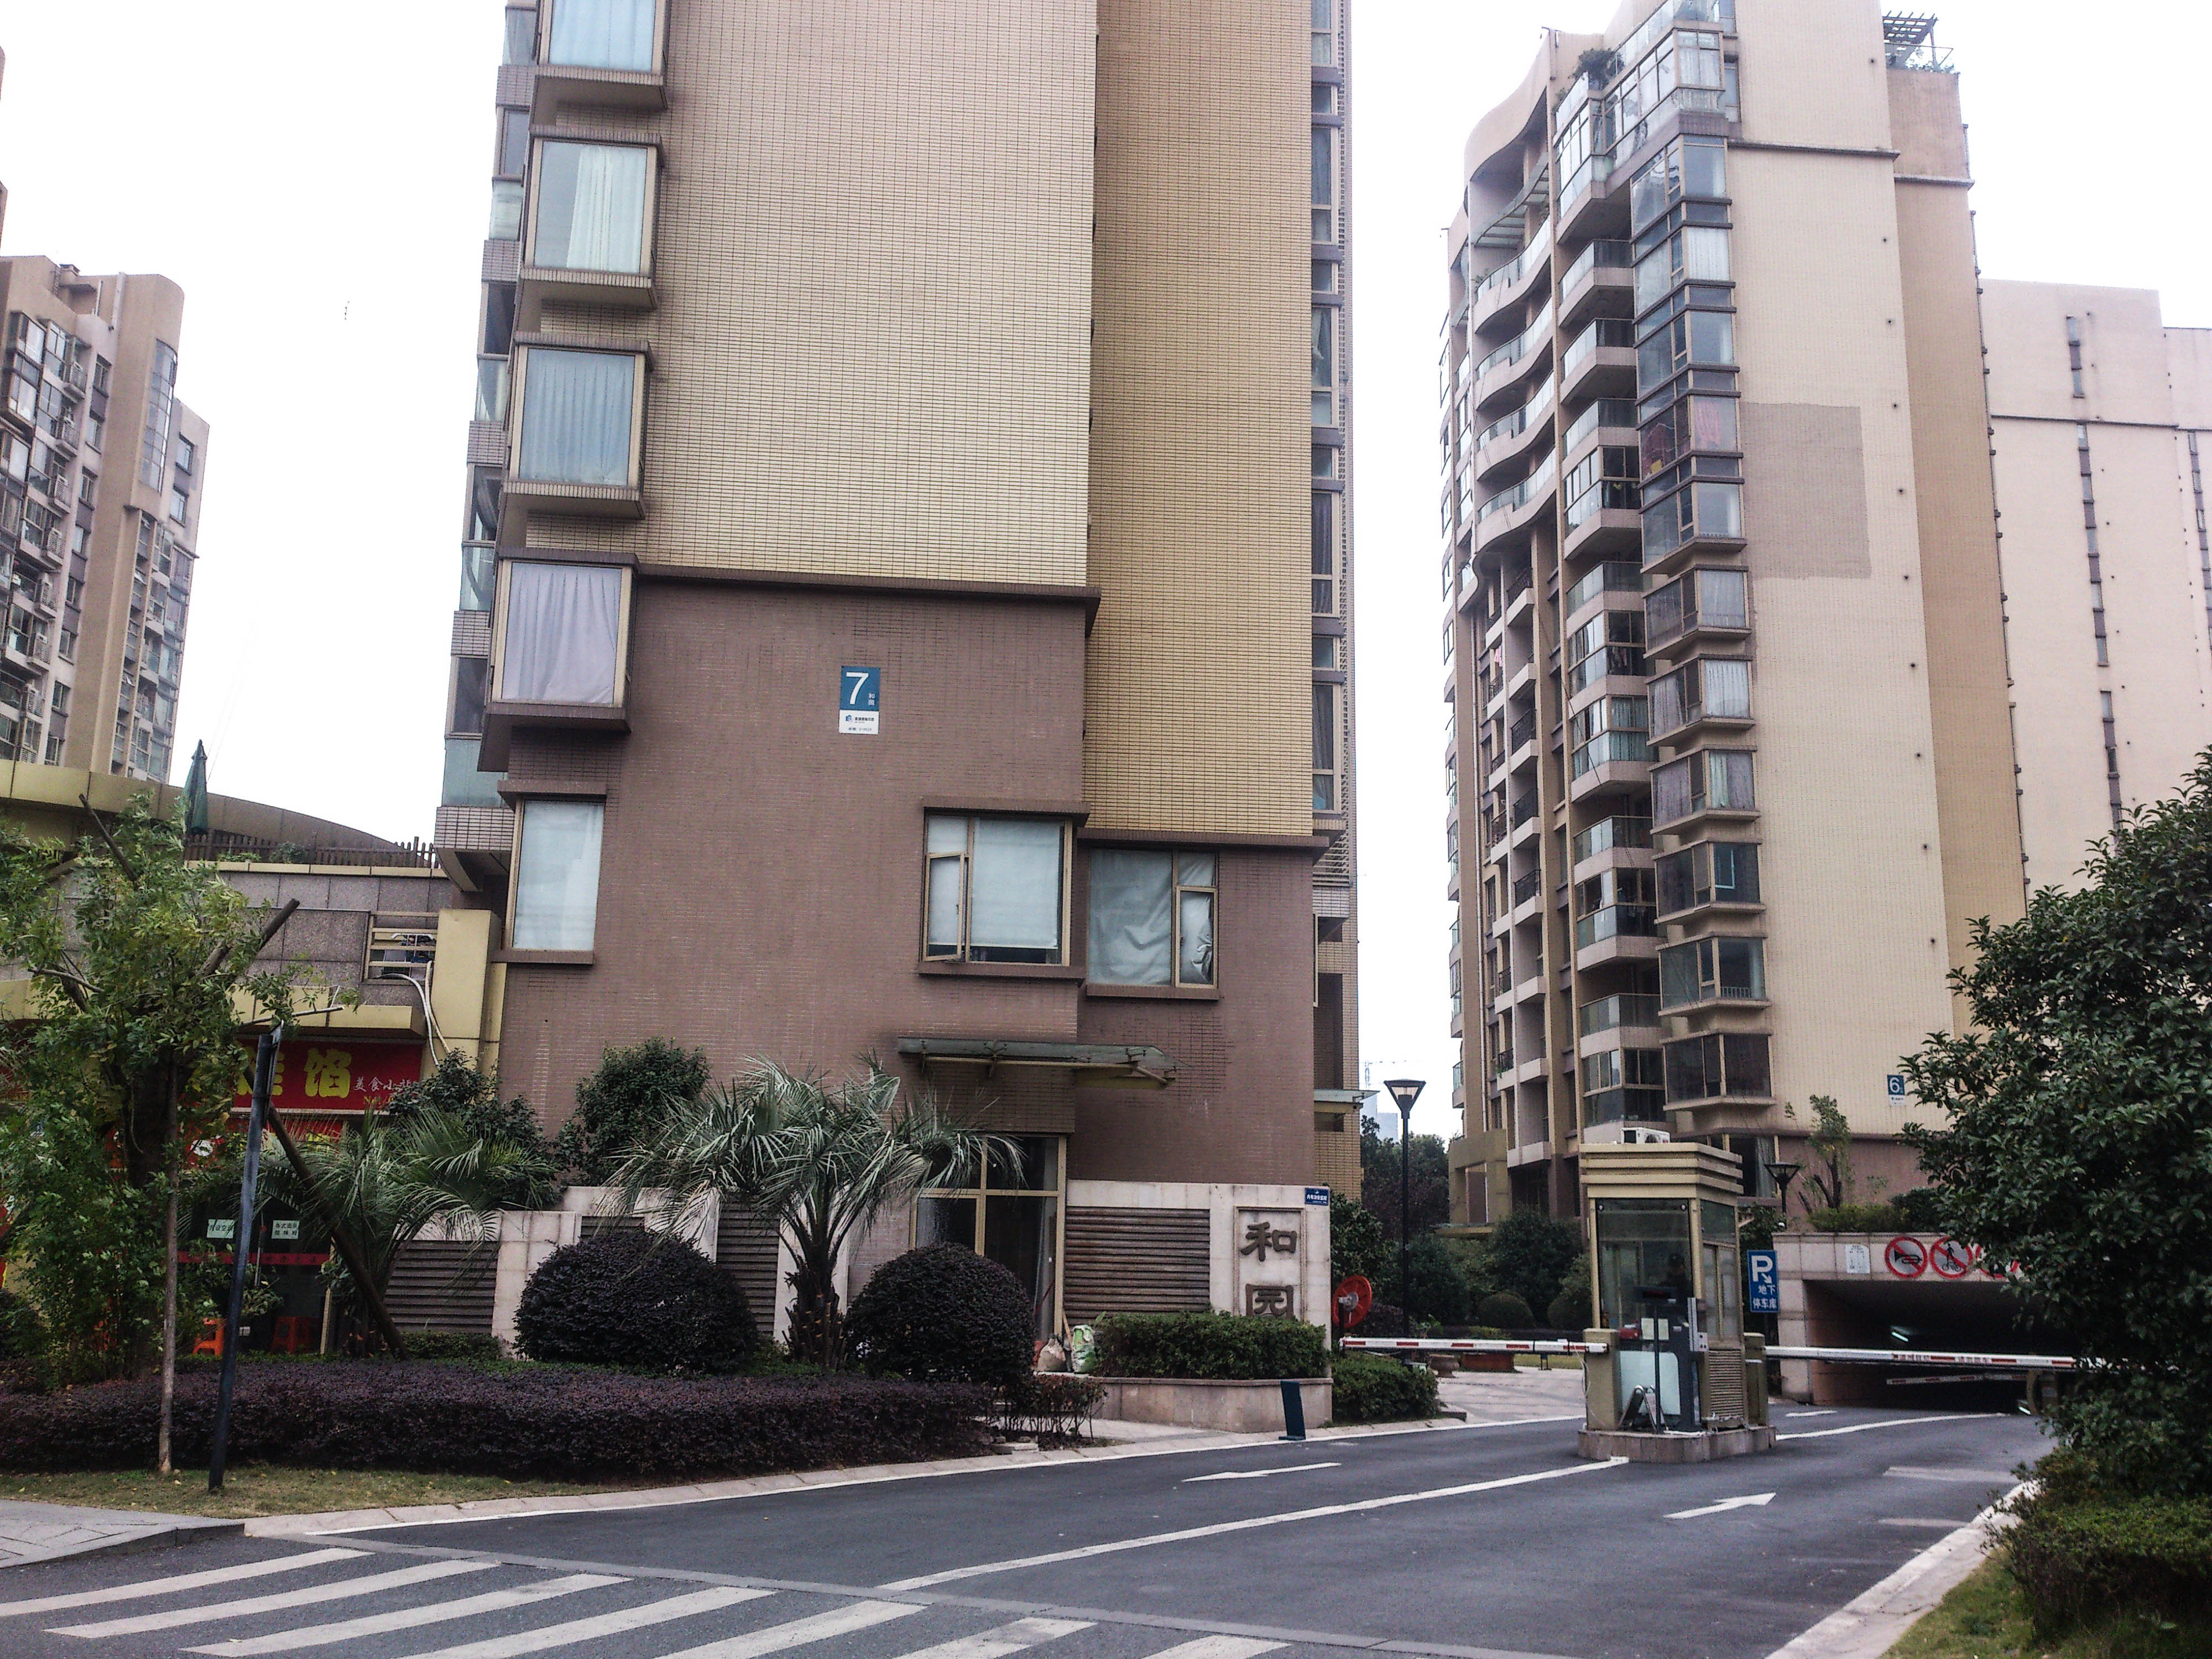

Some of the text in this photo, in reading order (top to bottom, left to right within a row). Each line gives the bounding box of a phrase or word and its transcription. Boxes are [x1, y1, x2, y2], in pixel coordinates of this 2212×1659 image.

[846, 672, 869, 705] 7
[1890, 1077, 1900, 1092] 6
[1240, 1222, 1297, 1318] 和园
[1751, 1255, 1773, 1282] P
[1758, 1284, 1776, 1296] 地下
[1752, 1297, 1777, 1310] 停车库
